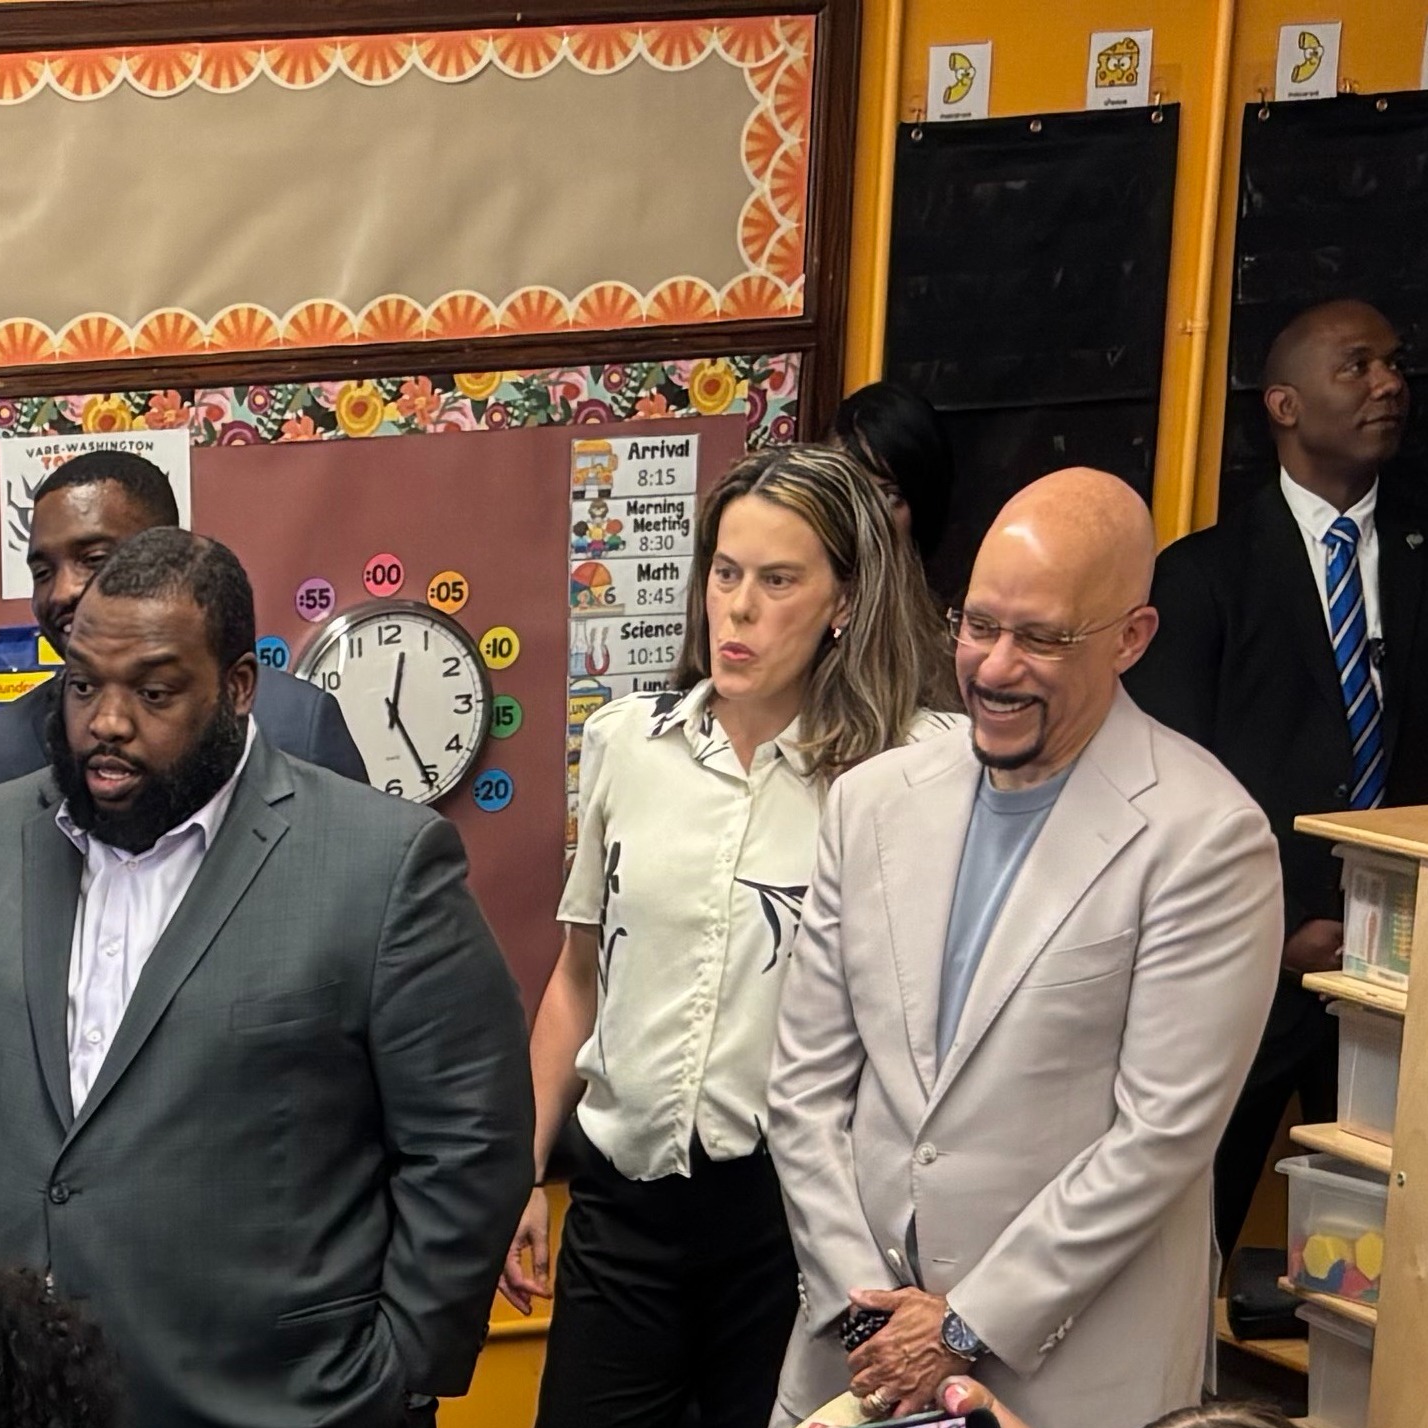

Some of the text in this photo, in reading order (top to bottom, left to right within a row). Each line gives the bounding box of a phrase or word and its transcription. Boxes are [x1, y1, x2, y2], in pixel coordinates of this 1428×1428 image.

[26, 441, 154, 458] VARE-WASHINGTON
[628, 439, 689, 460] Arrival
[637, 468, 675, 487] 8:15
[627, 499, 684, 520] Morning
[634, 516, 690, 537] Meeting
[639, 535, 674, 552] 8:30
[365, 564, 401, 585] :00
[637, 563, 679, 583] Math
[299, 587, 331, 609] :55
[430, 581, 464, 602] :05
[637, 587, 675, 605] 8:45
[378, 625, 401, 646] 12
[620, 620, 683, 640] Science
[349, 638, 362, 658] 11
[486, 638, 512, 658] :10
[627, 646, 675, 666] 10:15
[442, 657, 461, 678] 2
[321, 671, 341, 691] 10
[633, 678, 669, 692] Lunc
[453, 694, 473, 715] 3
[445, 734, 464, 753] 4
